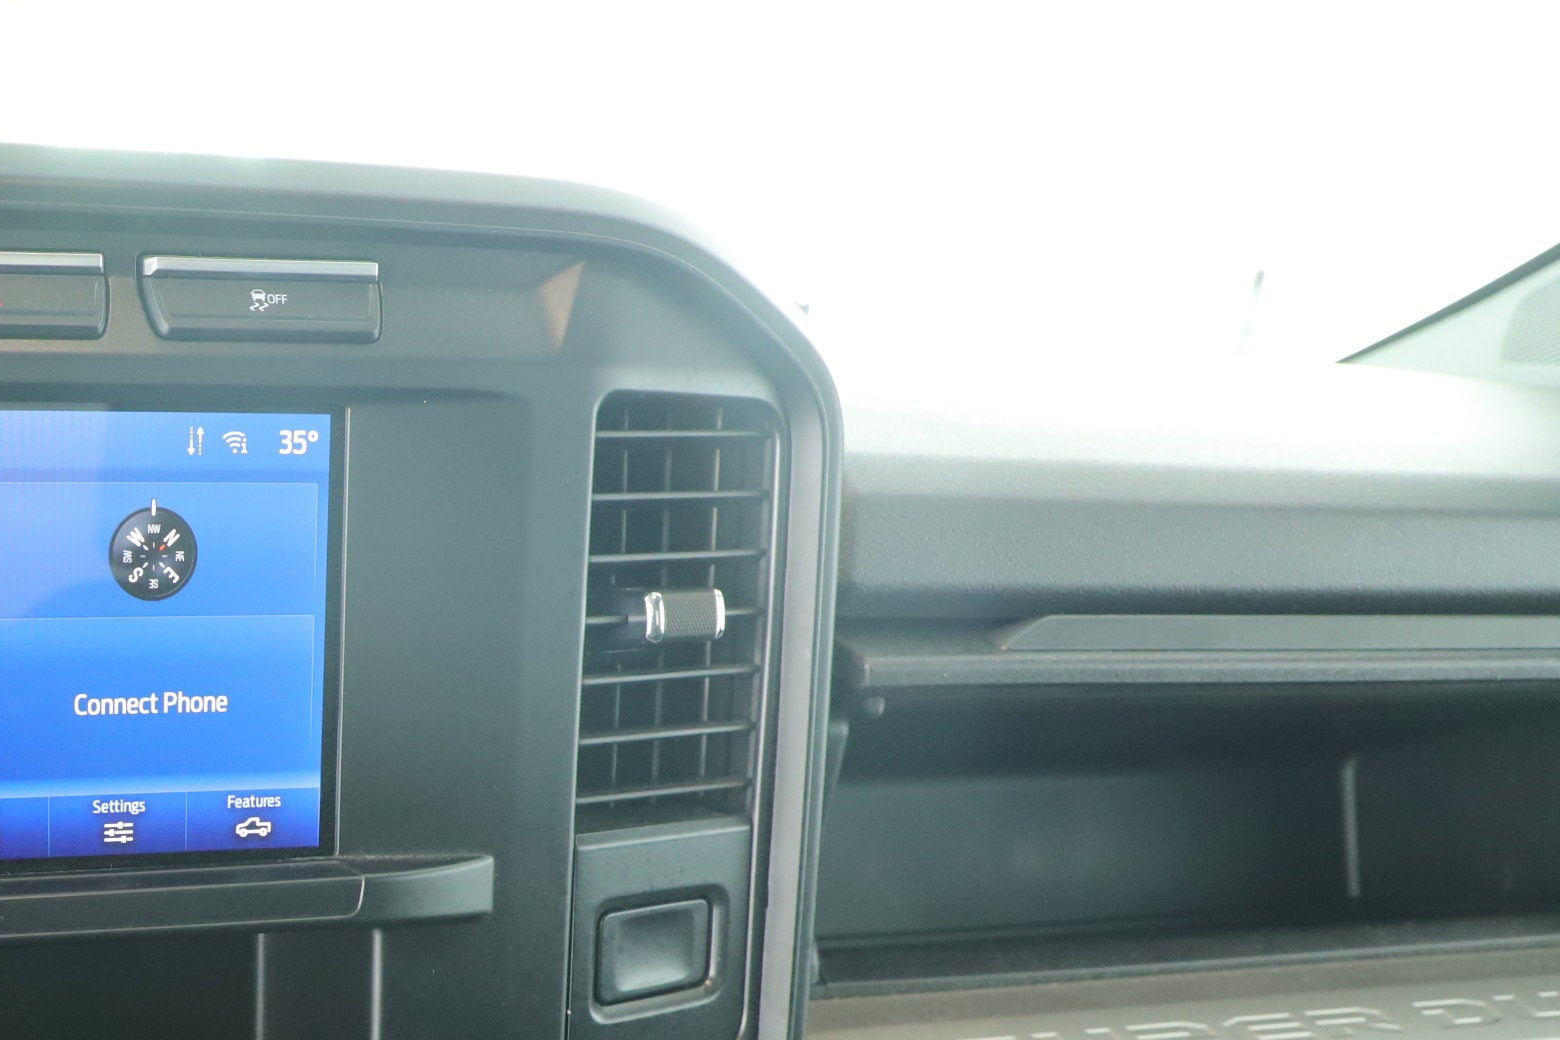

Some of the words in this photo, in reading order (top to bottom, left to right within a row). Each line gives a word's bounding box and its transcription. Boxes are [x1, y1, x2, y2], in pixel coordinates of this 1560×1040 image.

[266, 292, 289, 305] OFF
[278, 429, 319, 455] 35°
[147, 523, 162, 535] NW
[162, 528, 181, 548] N
[122, 549, 133, 564] SW
[175, 550, 185, 562] NE
[128, 566, 144, 583] S
[163, 566, 180, 584] E
[148, 578, 159, 589] SE
[73, 692, 159, 716] Connect
[163, 690, 229, 714] Phone
[92, 799, 146, 815] Settings
[227, 794, 282, 809] Features
